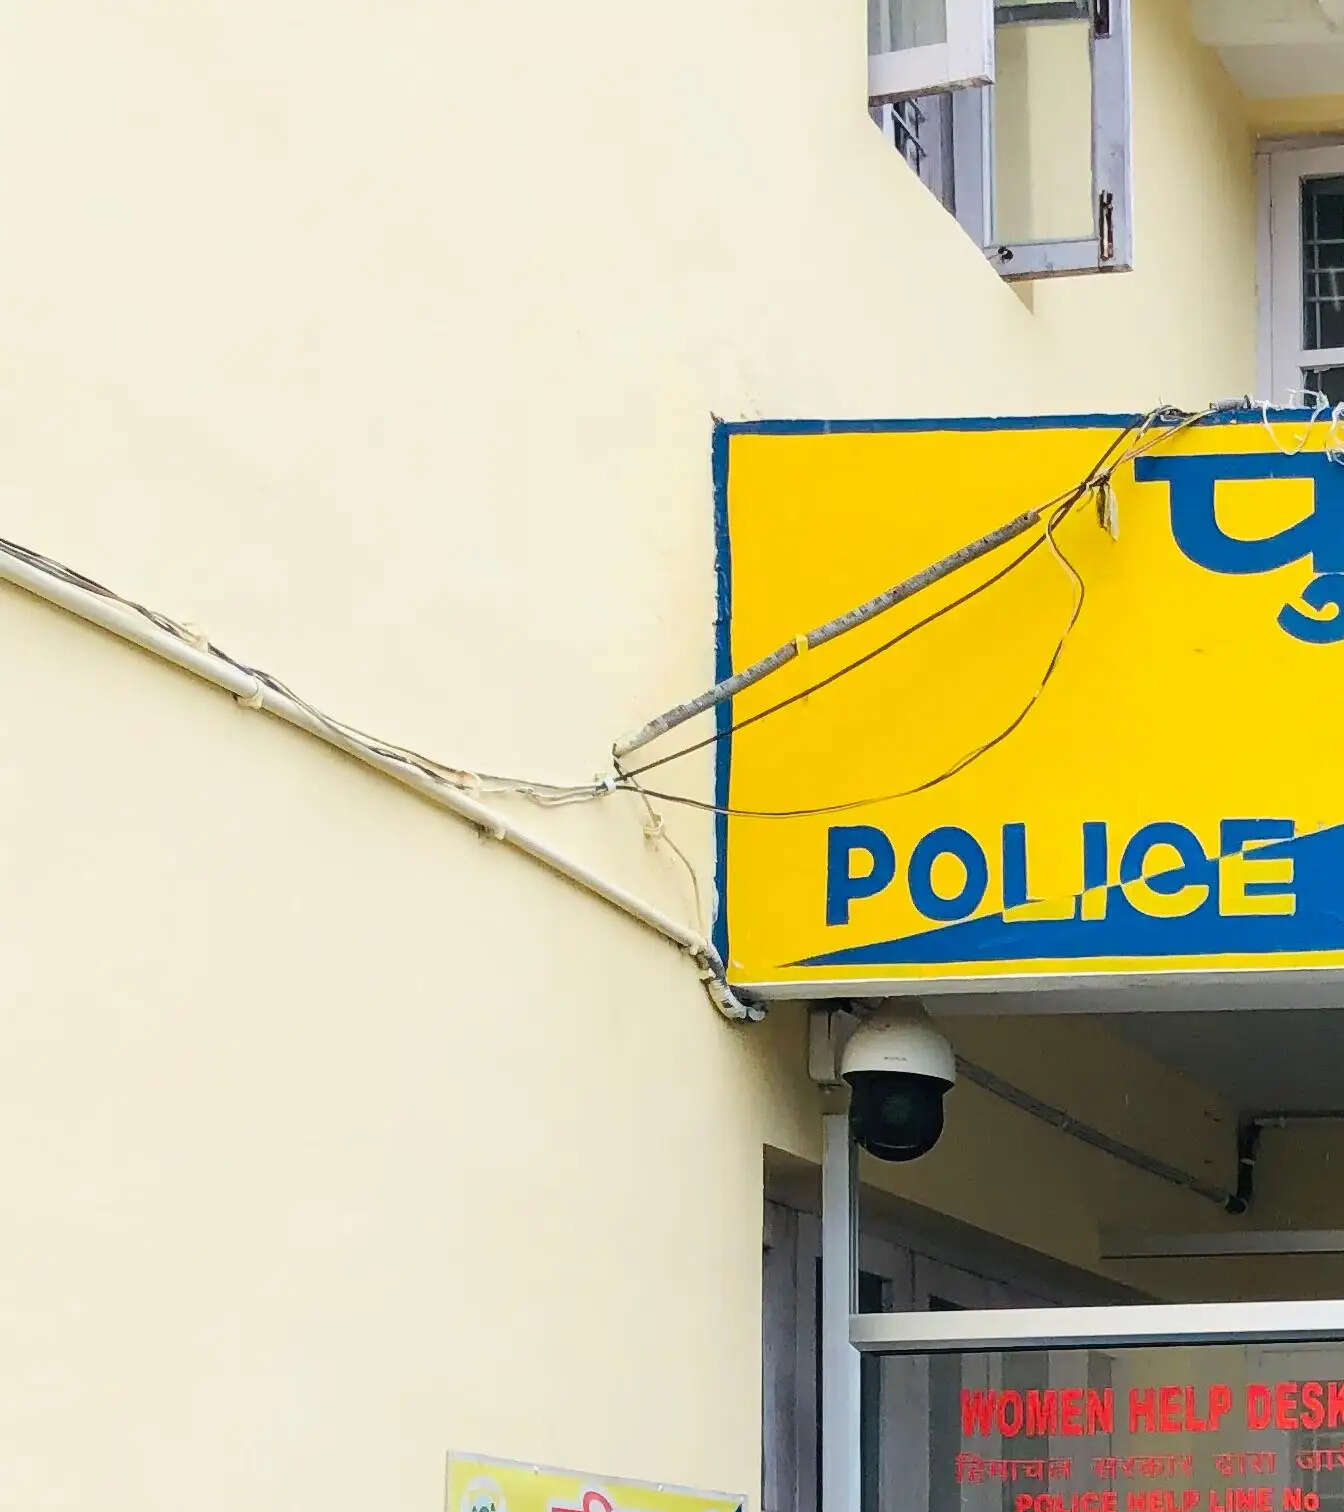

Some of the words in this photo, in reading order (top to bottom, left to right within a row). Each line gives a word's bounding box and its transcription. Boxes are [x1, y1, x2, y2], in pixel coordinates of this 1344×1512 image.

[827, 817, 1297, 926] POLICE
[961, 1386, 1114, 1438] WOMEN
[1129, 1383, 1232, 1434] HELP
[1282, 1487, 1320, 1512] No
